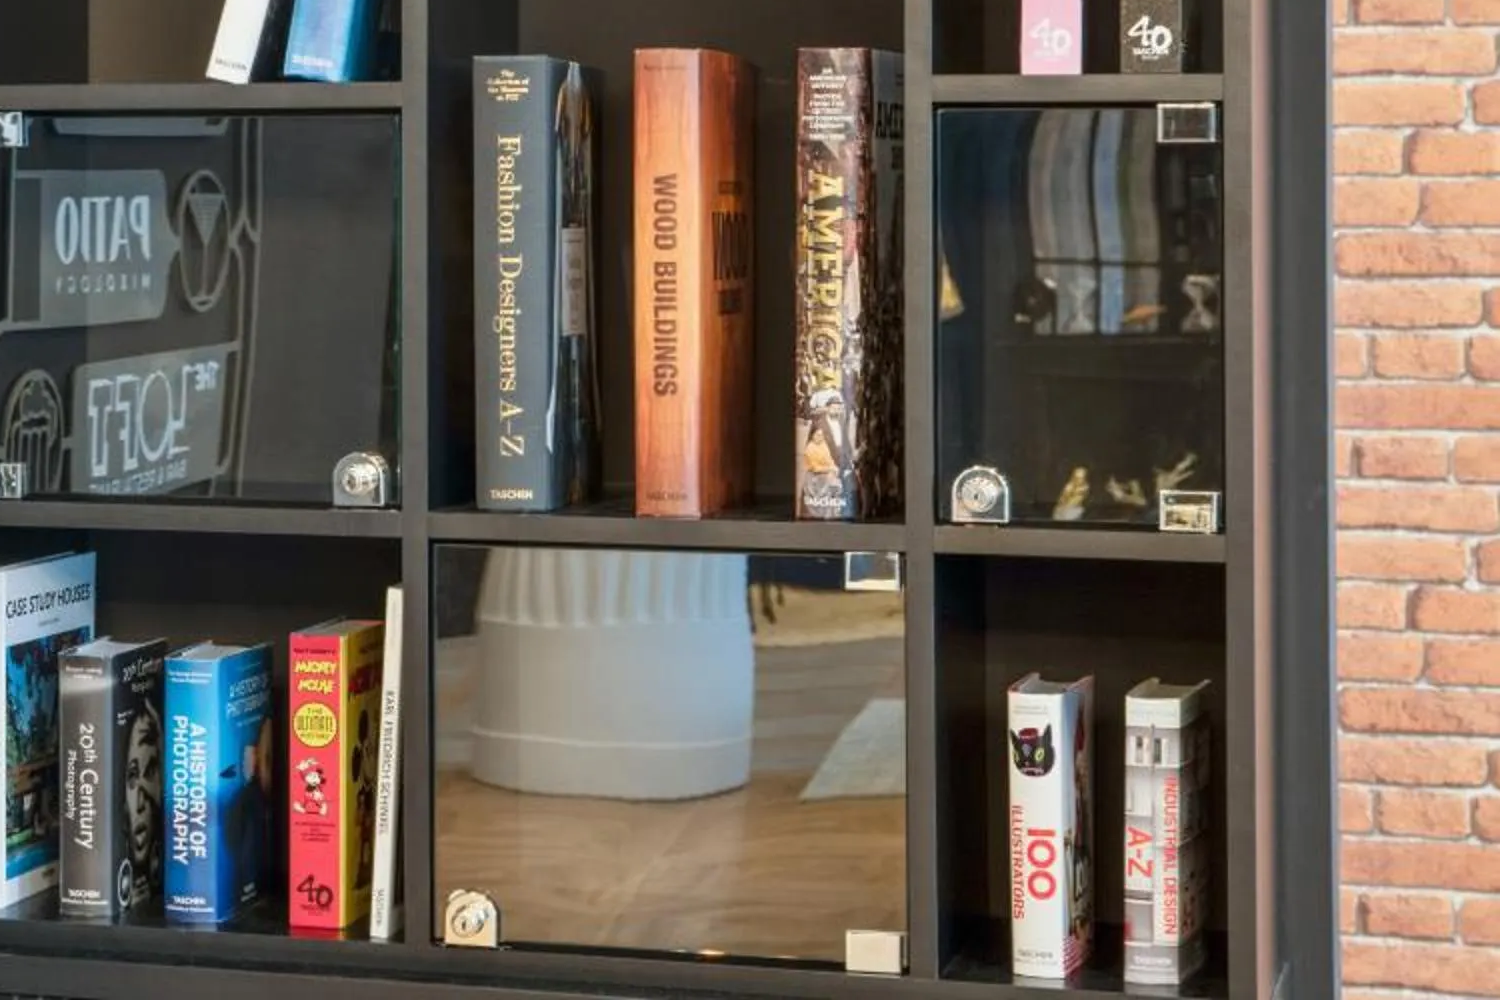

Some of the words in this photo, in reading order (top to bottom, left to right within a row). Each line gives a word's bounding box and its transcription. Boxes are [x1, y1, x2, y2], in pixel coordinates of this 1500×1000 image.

[1127, 15, 1173, 52] 40
[495, 134, 523, 245] Fashion
[652, 173, 680, 251] WOOD
[806, 169, 846, 397] AMERICA
[493, 251, 525, 391] Designers
[652, 260, 680, 398] BUILDINGS
[500, 400, 525, 457] A-Z
[490, 489, 534, 501] TASCHEN
[5, 597, 28, 619] CASE
[30, 590, 57, 614] STUDY
[57, 583, 91, 607] HOUSES
[77, 722, 97, 764] 20th
[190, 723, 208, 737] A
[64, 748, 78, 822] Photography
[73, 764, 100, 851] Century
[173, 715, 189, 867] PHOTOGRAPHY
[190, 740, 208, 824] HISTORY
[190, 825, 208, 859] OF
[1127, 826, 1154, 879] A-Z
[1162, 773, 1179, 873] INDUSTRIAL
[297, 875, 334, 911] 40
[1011, 804, 1025, 920] ILLUSTRATORS
[1027, 828, 1057, 901] 100
[1163, 875, 1178, 936] DESIGN
